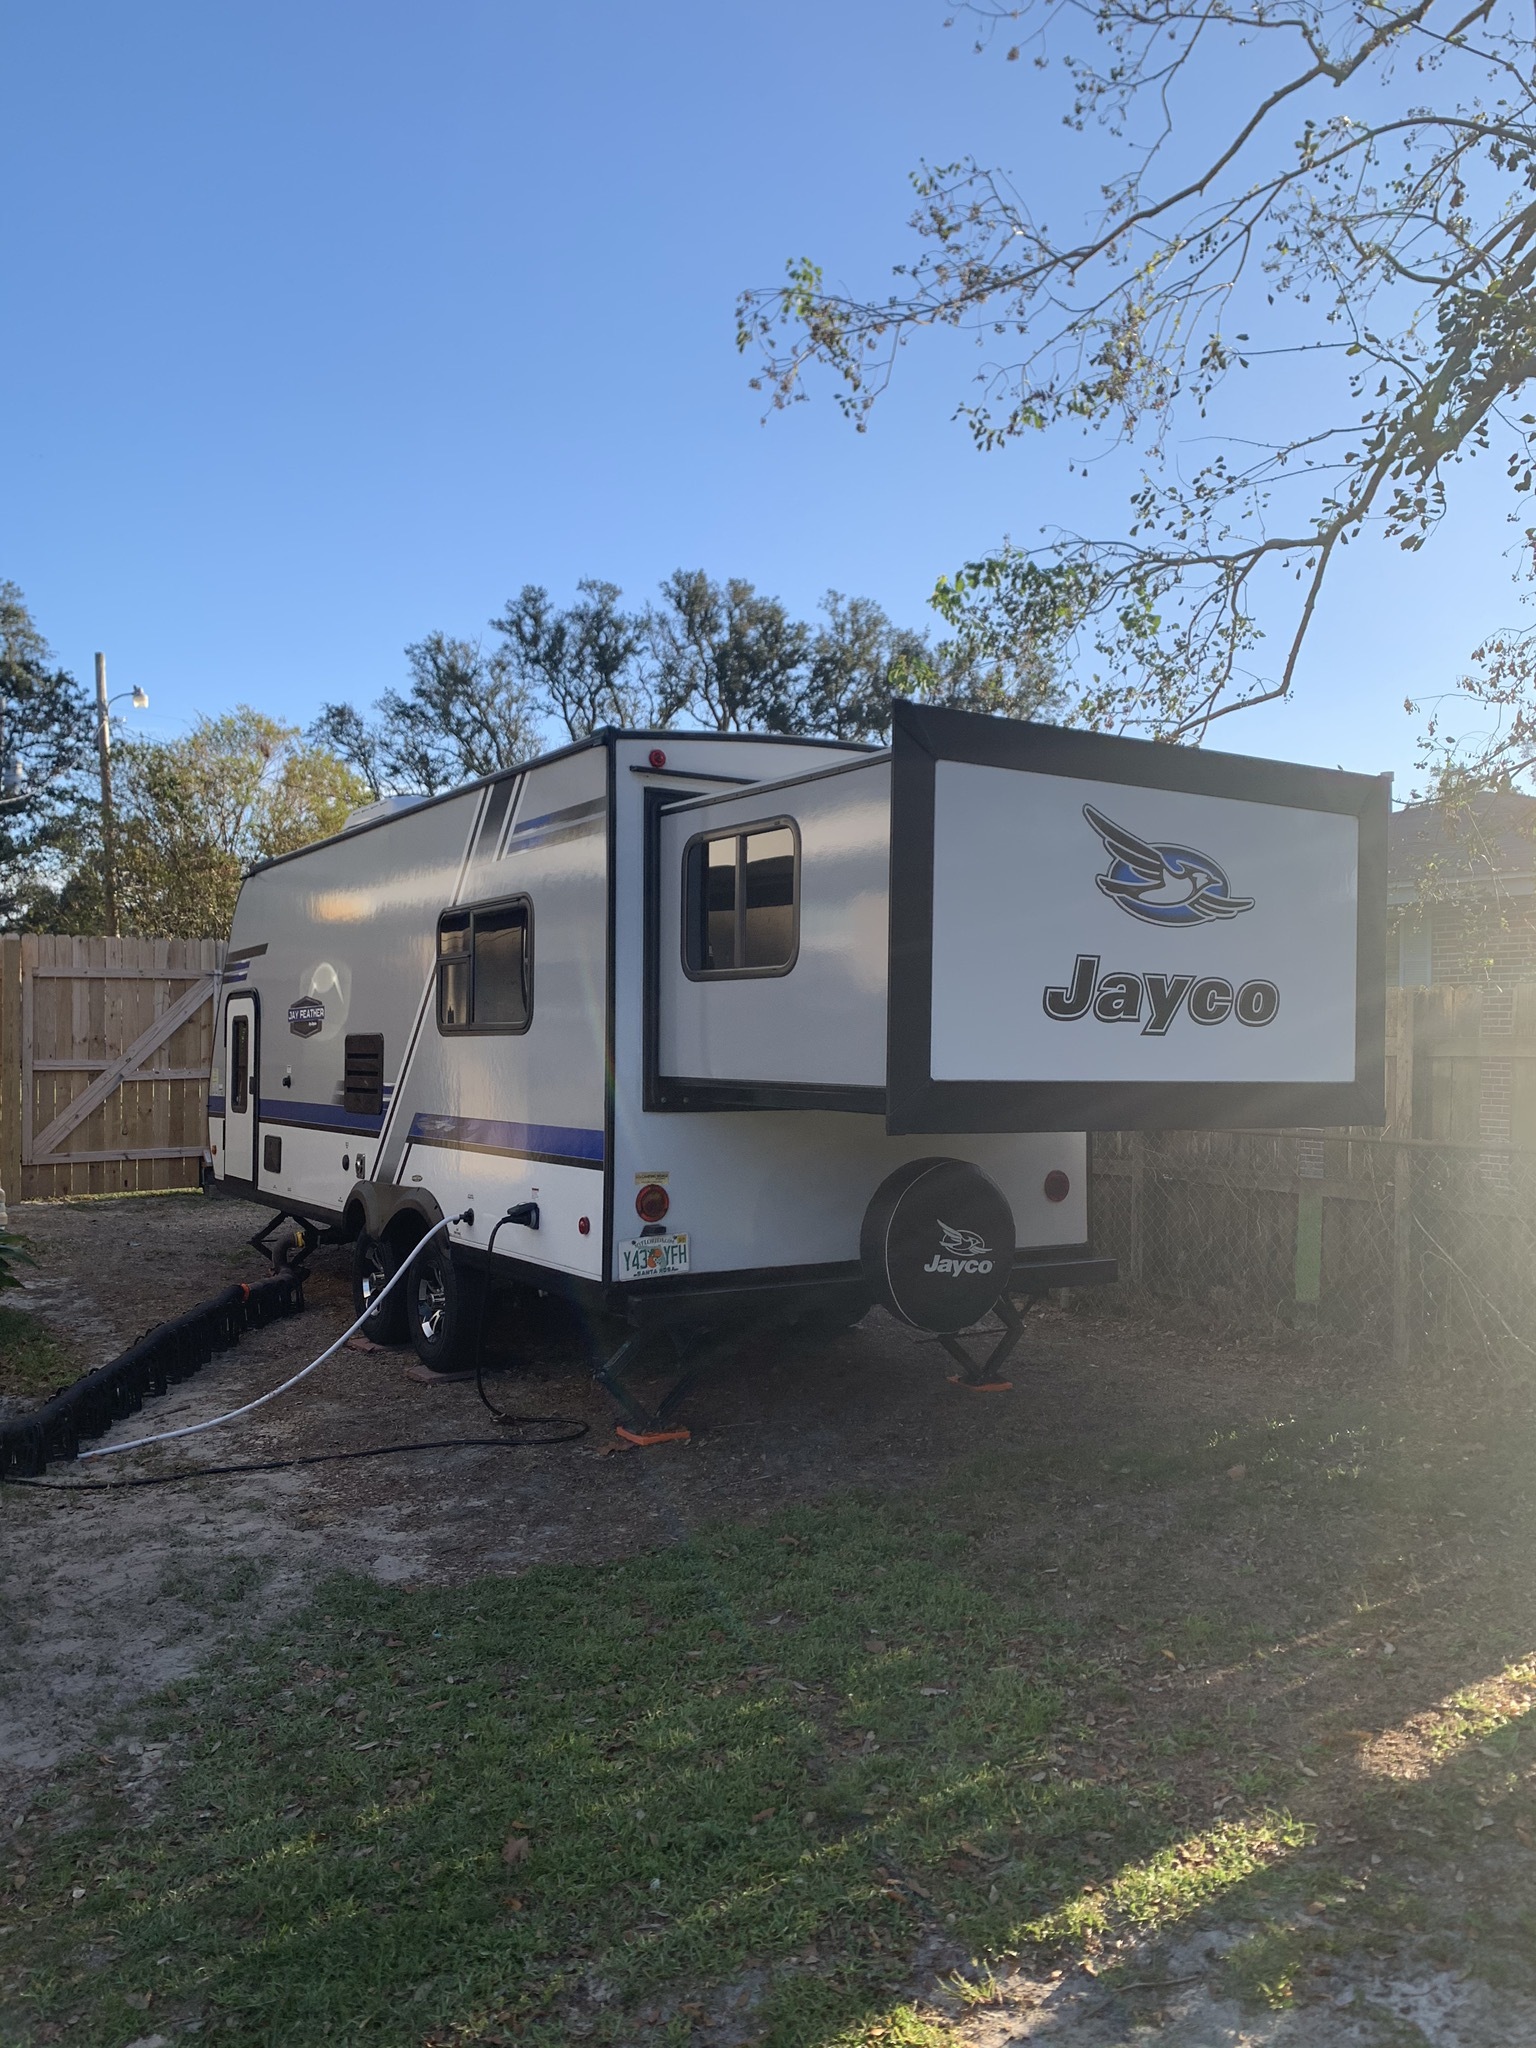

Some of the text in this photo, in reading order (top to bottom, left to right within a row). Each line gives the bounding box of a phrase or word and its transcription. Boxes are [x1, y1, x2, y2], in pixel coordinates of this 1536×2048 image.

[1043, 954, 1280, 1036] Jayco
[288, 1008, 324, 1020] JAY FEATHER
[623, 1244, 687, 1271] Y43 YFH
[924, 1254, 993, 1277] Jayco
